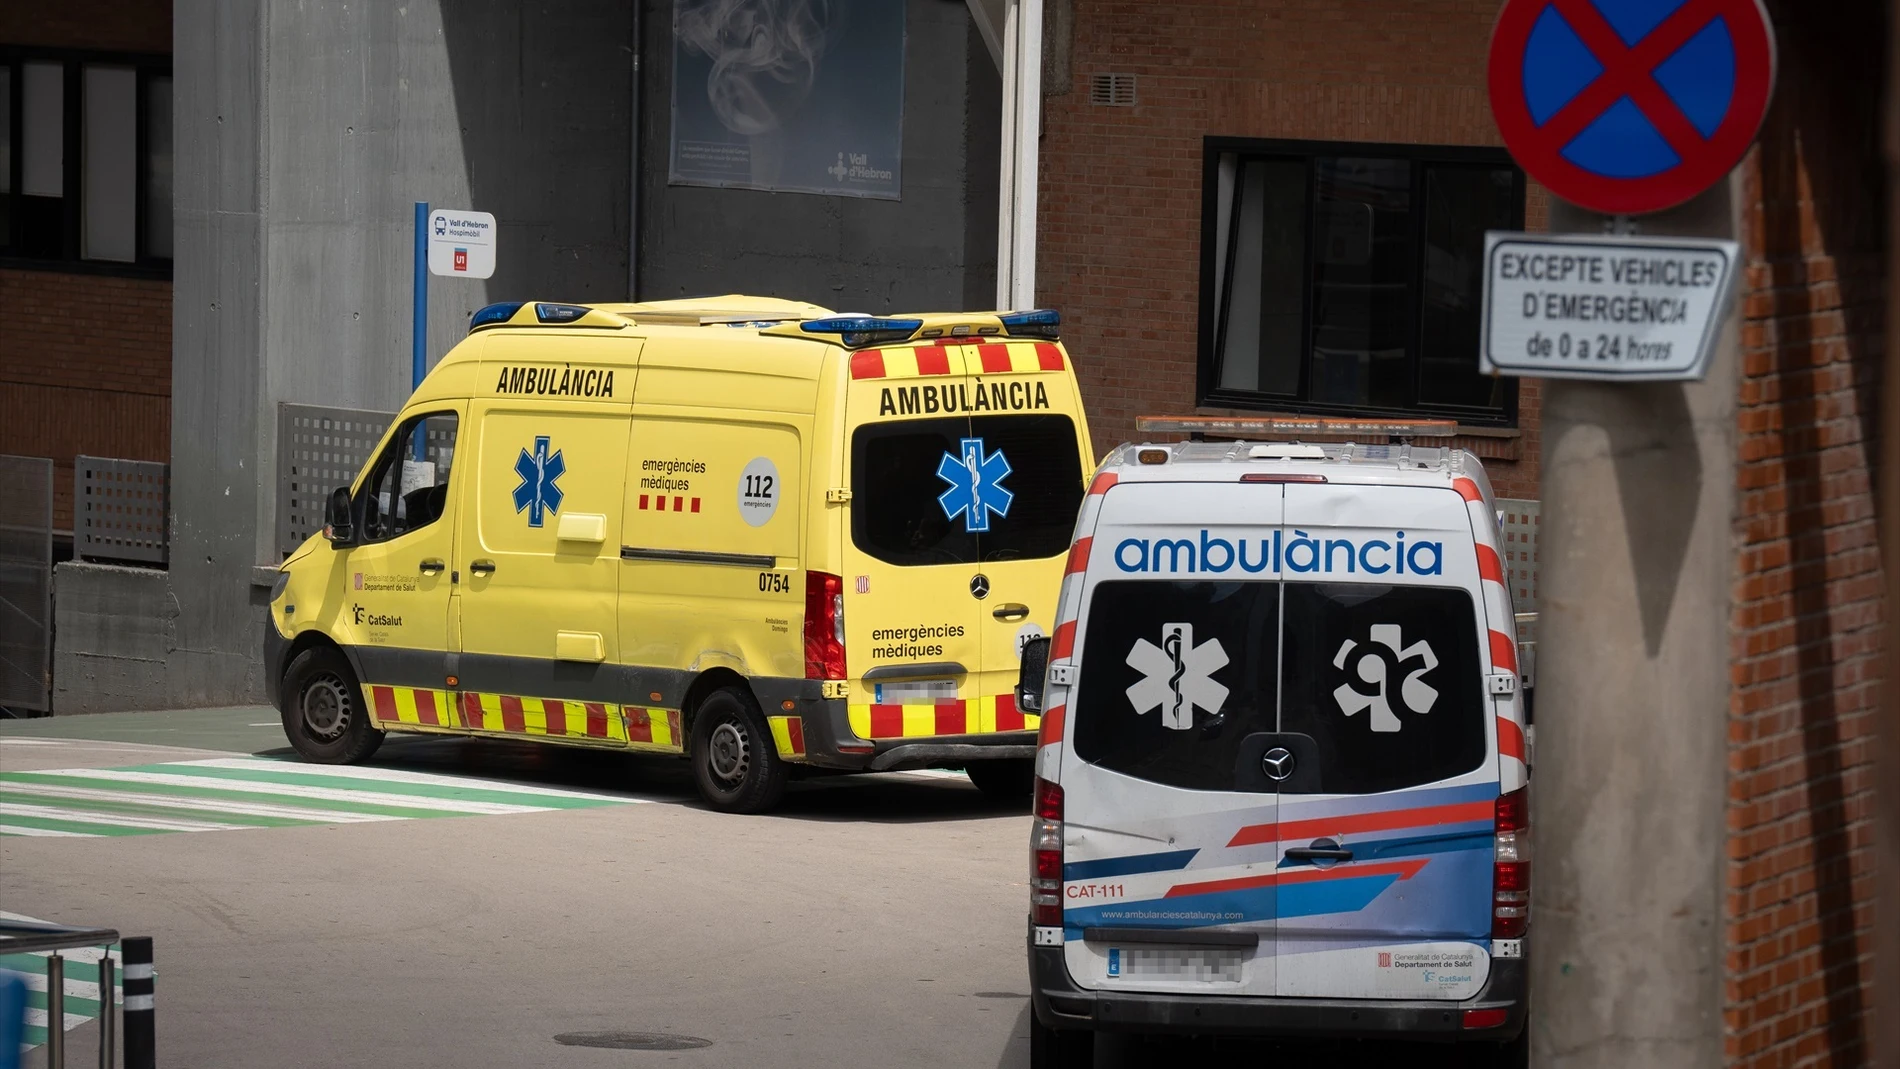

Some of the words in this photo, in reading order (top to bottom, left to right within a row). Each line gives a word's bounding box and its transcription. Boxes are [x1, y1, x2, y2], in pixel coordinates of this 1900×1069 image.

[849, 153, 867, 165] Vall
[849, 165, 892, 179] d'Hebron
[461, 220, 489, 229] d'Hebron
[449, 229, 481, 237] Hospimòbil
[456, 255, 465, 264] U1
[1500, 253, 1603, 281] EXCEPTE
[1610, 257, 1718, 287] VEHICLES
[1526, 332, 1553, 358] de
[1558, 333, 1571, 359] 0
[1577, 339, 1590, 360] a
[1596, 334, 1621, 361] 24
[1626, 335, 1672, 361] hores
[496, 363, 614, 398] AMBULÀNCIA
[879, 377, 1050, 416] AMBULÀNCIA
[642, 458, 706, 475] emergències
[640, 475, 689, 493] mèdiques
[744, 475, 774, 499] 112
[744, 500, 771, 508] emergències
[1114, 529, 1443, 576] ambulància
[364, 574, 389, 582] Generalitat
[397, 575, 420, 584] Catalunya
[759, 572, 790, 593] 0754
[364, 583, 395, 592] Departament
[395, 584, 402, 592] de
[403, 584, 416, 592] Salut
[368, 614, 403, 627] CatSalut
[872, 624, 965, 642] emergències
[872, 644, 943, 660] mèdiques
[1066, 884, 1124, 899] CAT-111
[1101, 910, 1244, 920] www.ambulanciescatalunya.com
[1394, 953, 1430, 961] Generalitat
[1431, 953, 1440, 961] de
[1441, 953, 1474, 961] Catalunya
[1394, 961, 1442, 969] Departament
